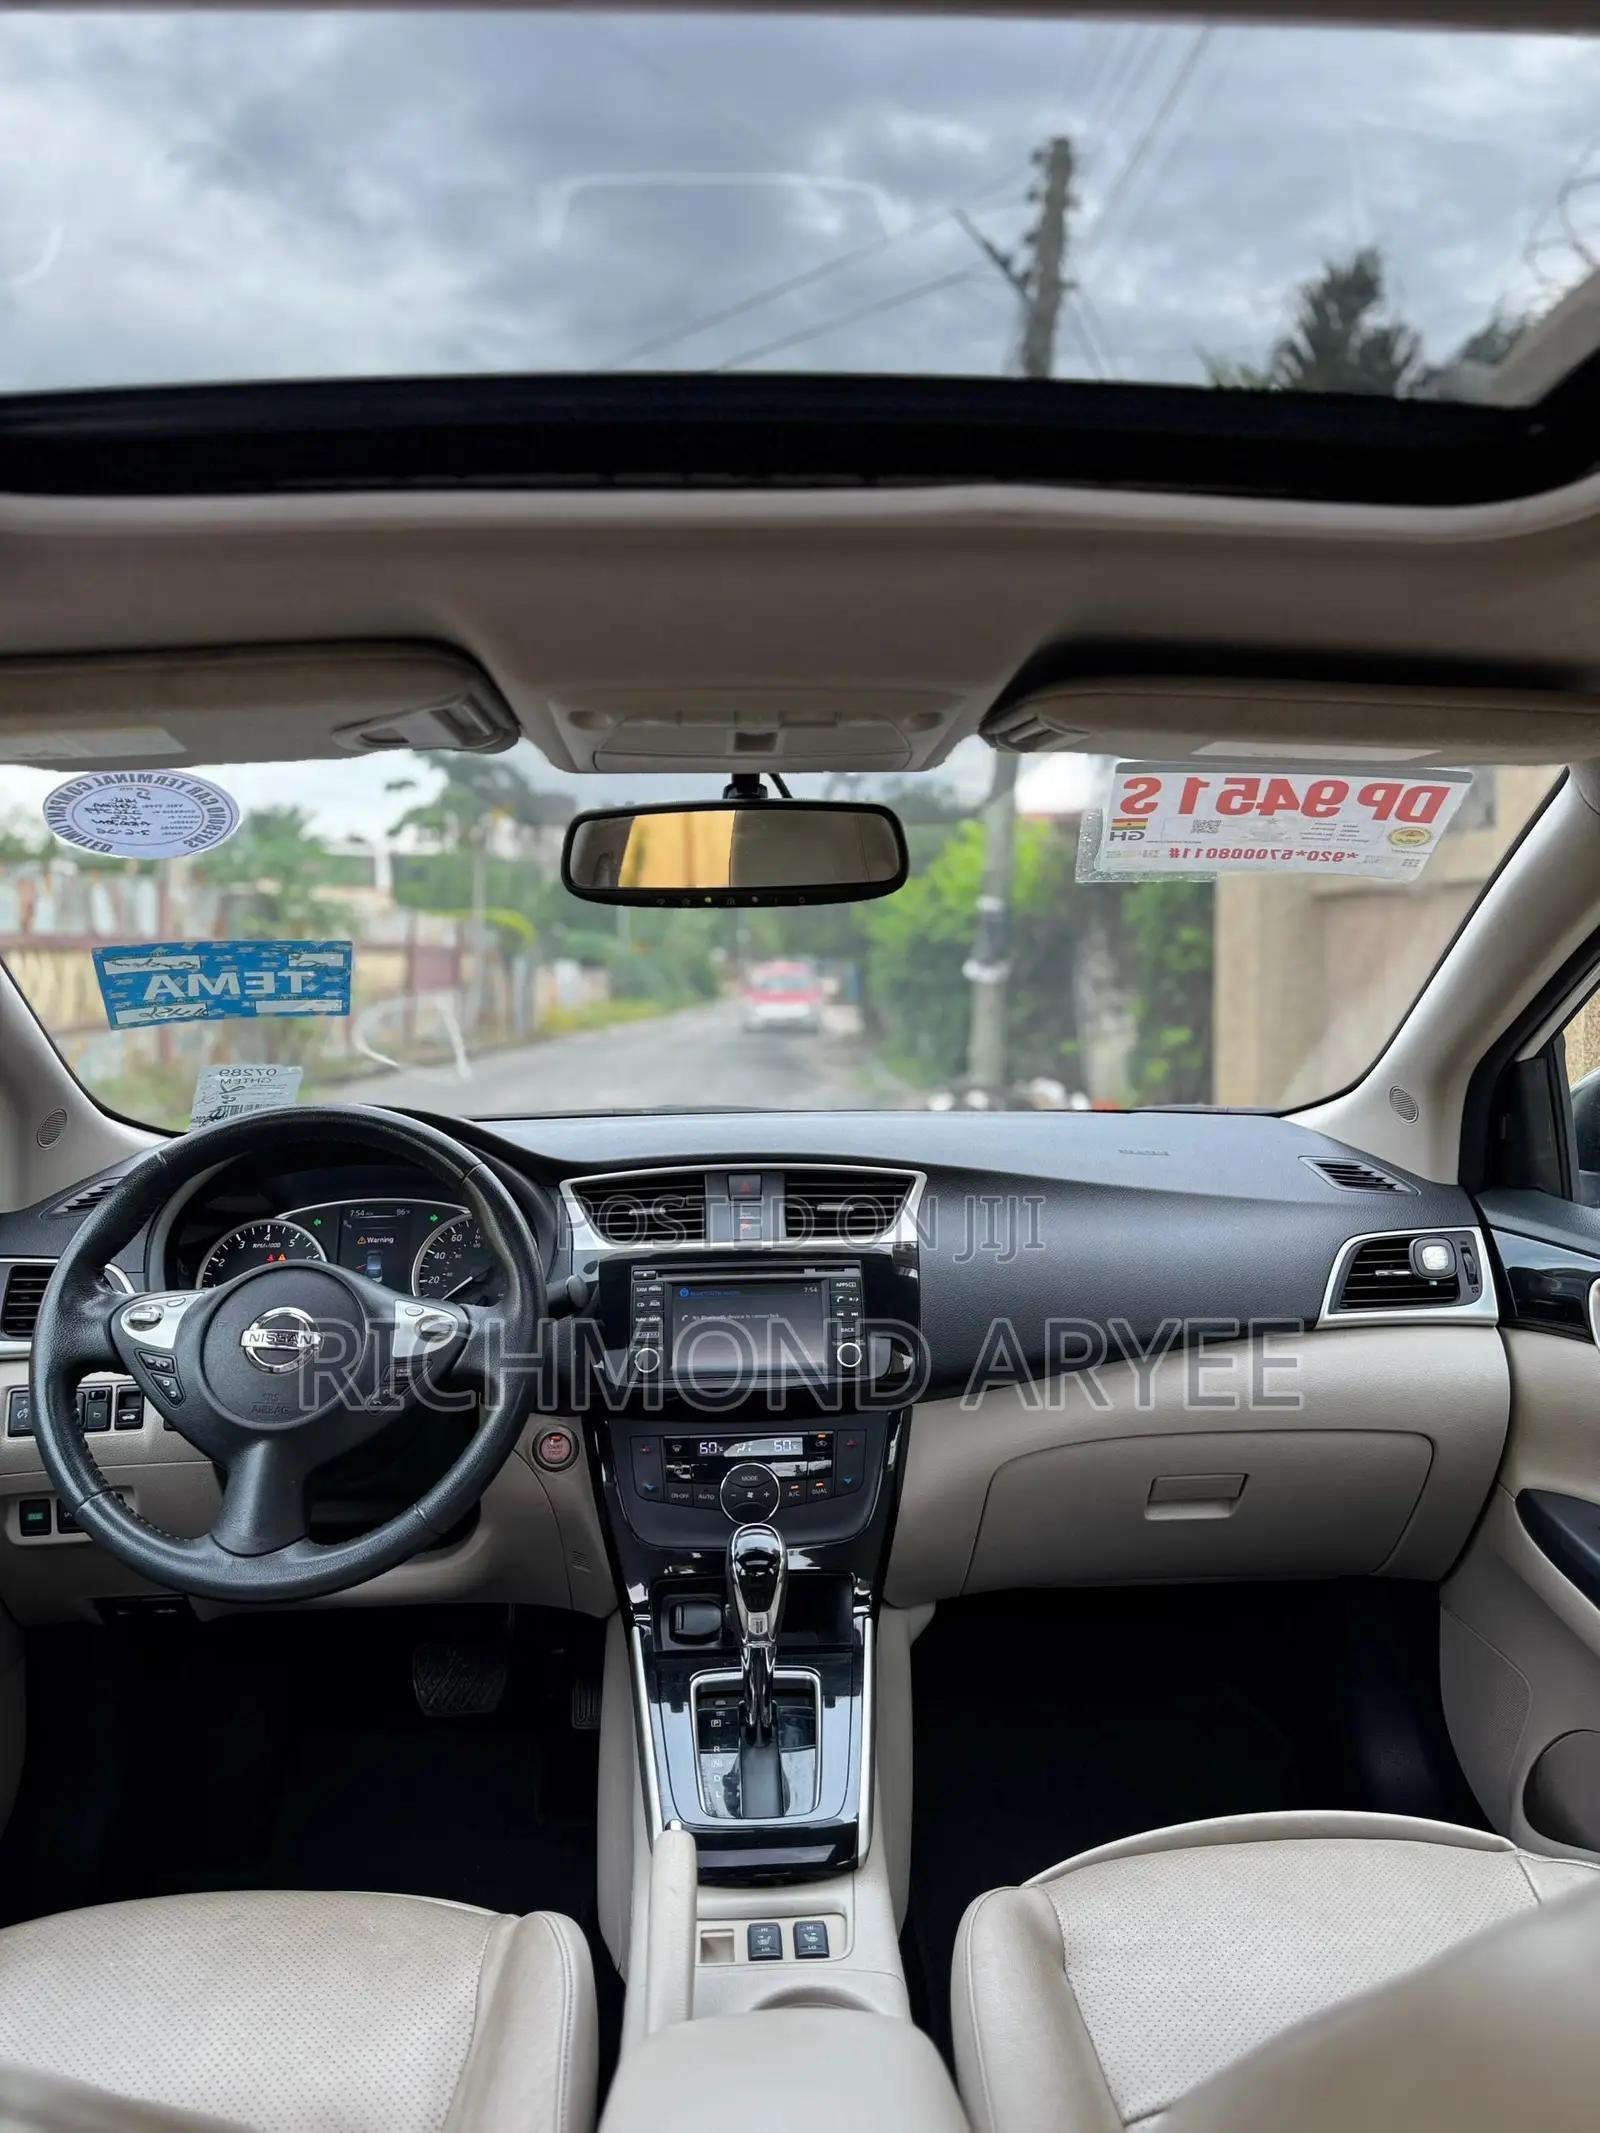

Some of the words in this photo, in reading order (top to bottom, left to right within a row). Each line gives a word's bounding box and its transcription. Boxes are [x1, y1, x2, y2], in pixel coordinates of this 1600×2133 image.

[263, 1233, 271, 1242] 4
[366, 1236, 395, 1245] Warning
[451, 1233, 463, 1242] 60
[238, 1240, 246, 1249] 3
[288, 1239, 296, 1248] 5
[433, 1251, 446, 1260] 40
[217, 1258, 226, 1267] 2
[428, 1275, 440, 1284] 20
[248, 1332, 313, 1345] NISSAN
[713, 1745, 720, 1753] R
[713, 1774, 721, 1782] D
